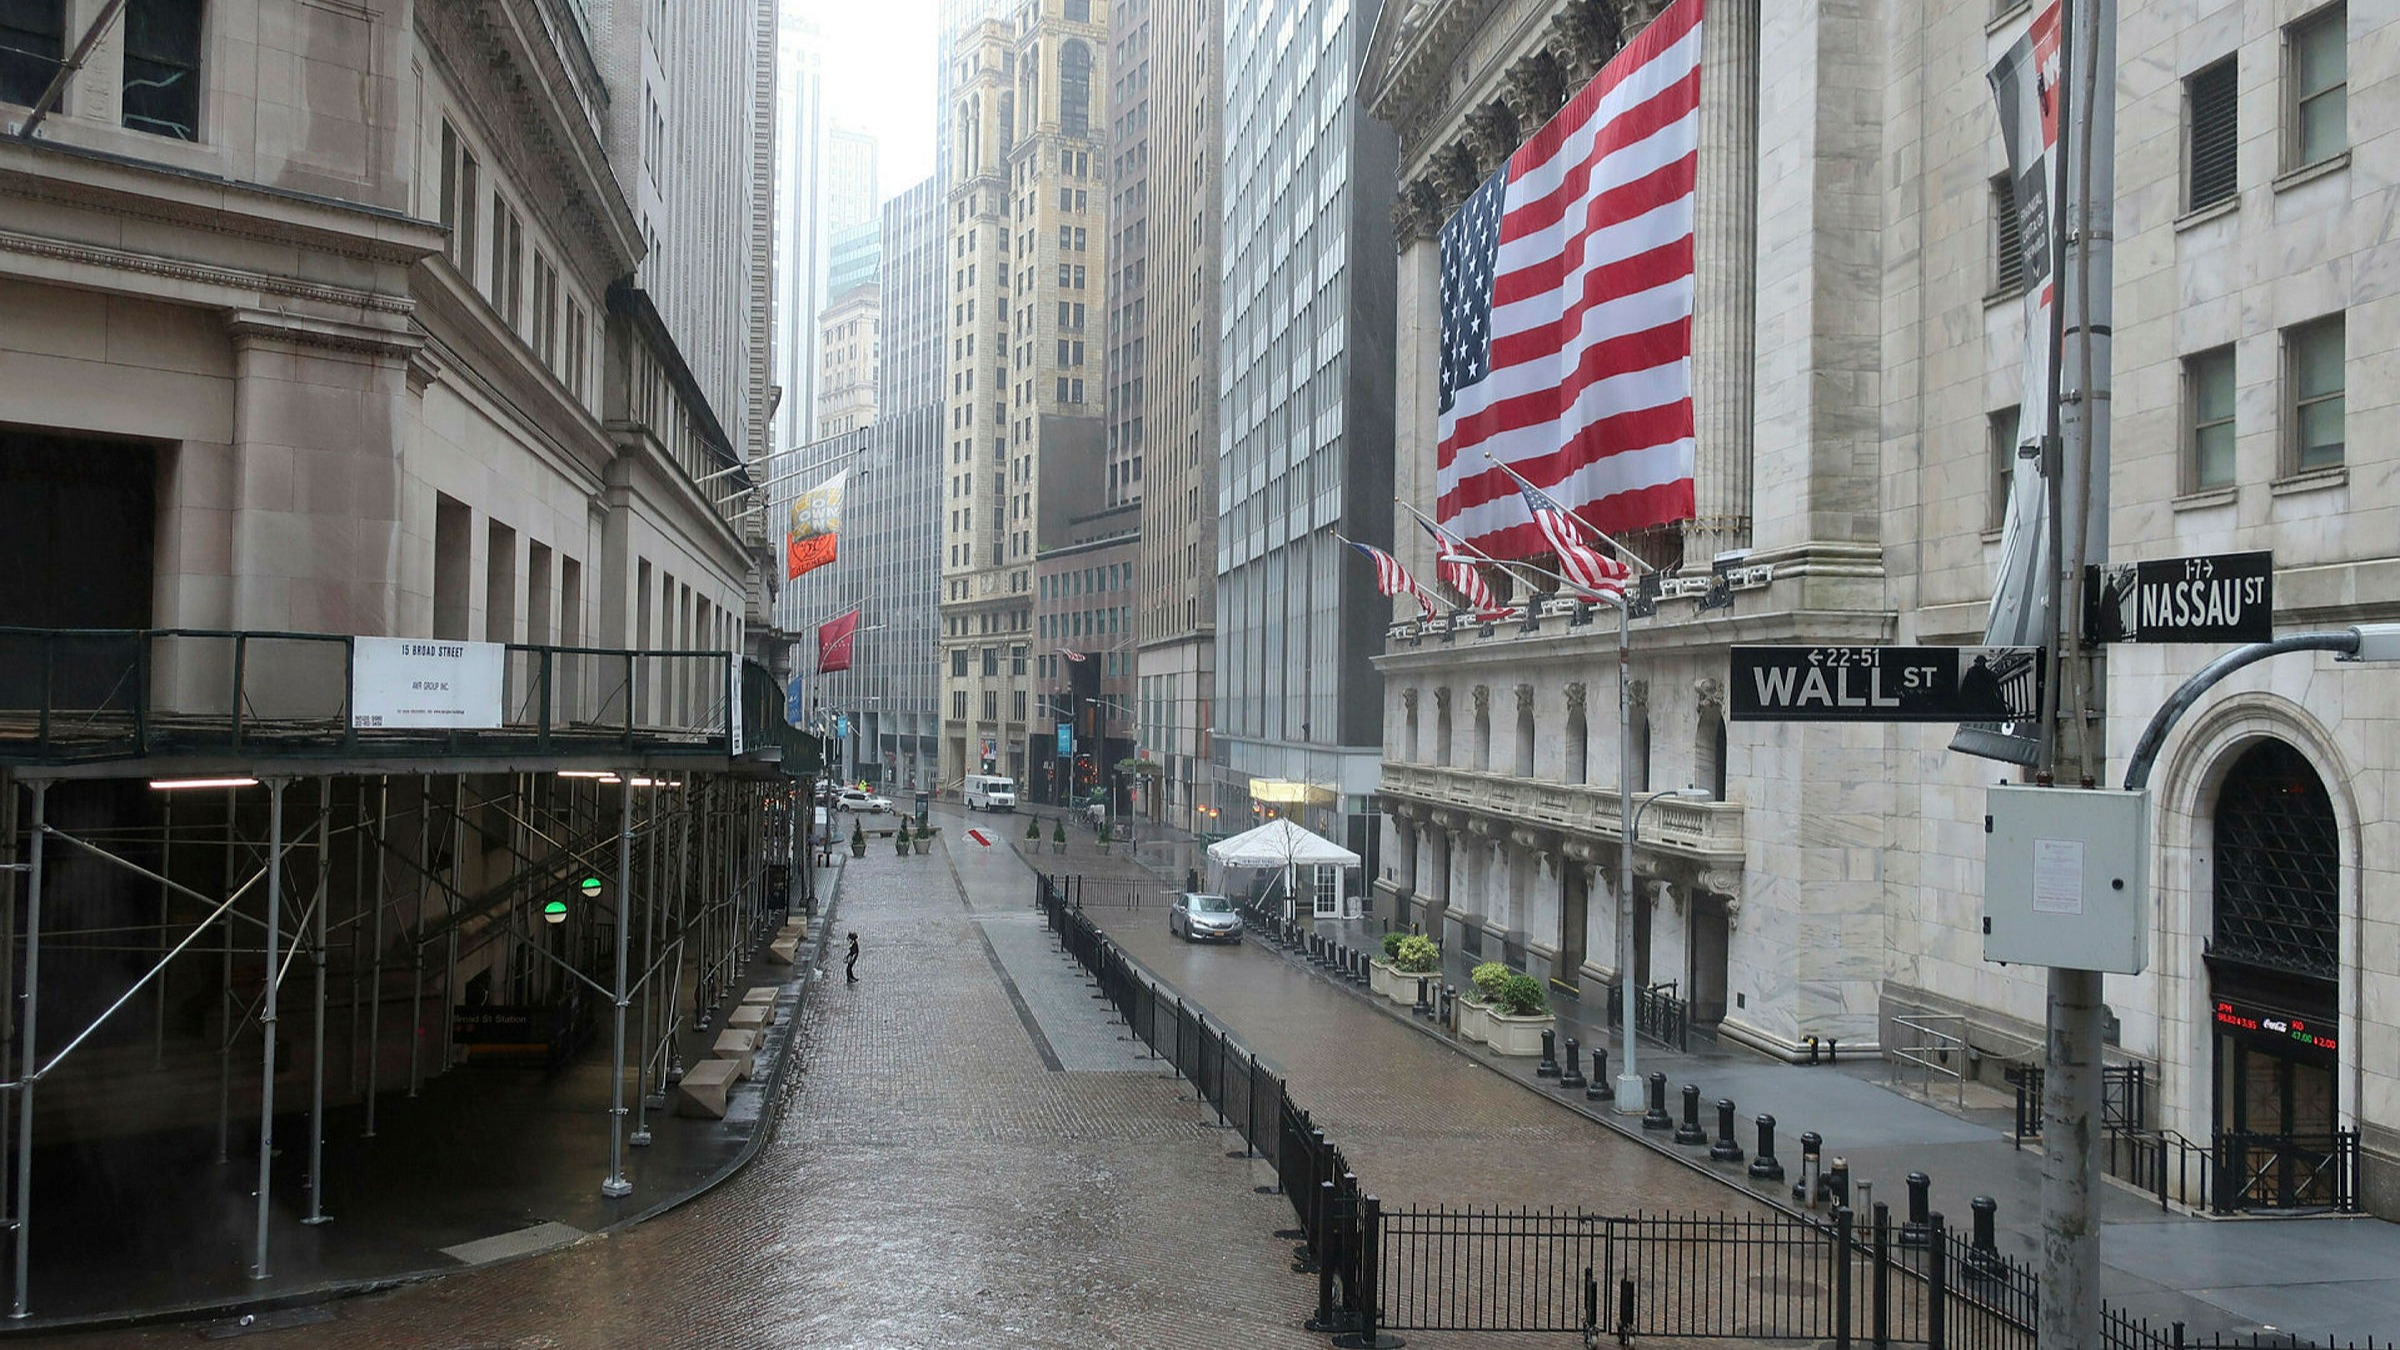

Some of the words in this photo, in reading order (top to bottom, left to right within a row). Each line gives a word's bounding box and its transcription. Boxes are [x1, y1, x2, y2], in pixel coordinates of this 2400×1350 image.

[2185, 559, 2202, 580] 1-7
[2142, 578, 2241, 628] NASSAU
[2244, 576, 2265, 605] ST
[402, 644, 410, 656] 15
[412, 645, 435, 657] BROAD
[438, 646, 464, 658] STREET
[1826, 648, 1880, 667] 22-51
[1753, 666, 1900, 707] WALL
[1903, 666, 1938, 688] ST
[2217, 1002, 2232, 1013] JPM
[495, 1014, 527, 1024] Station
